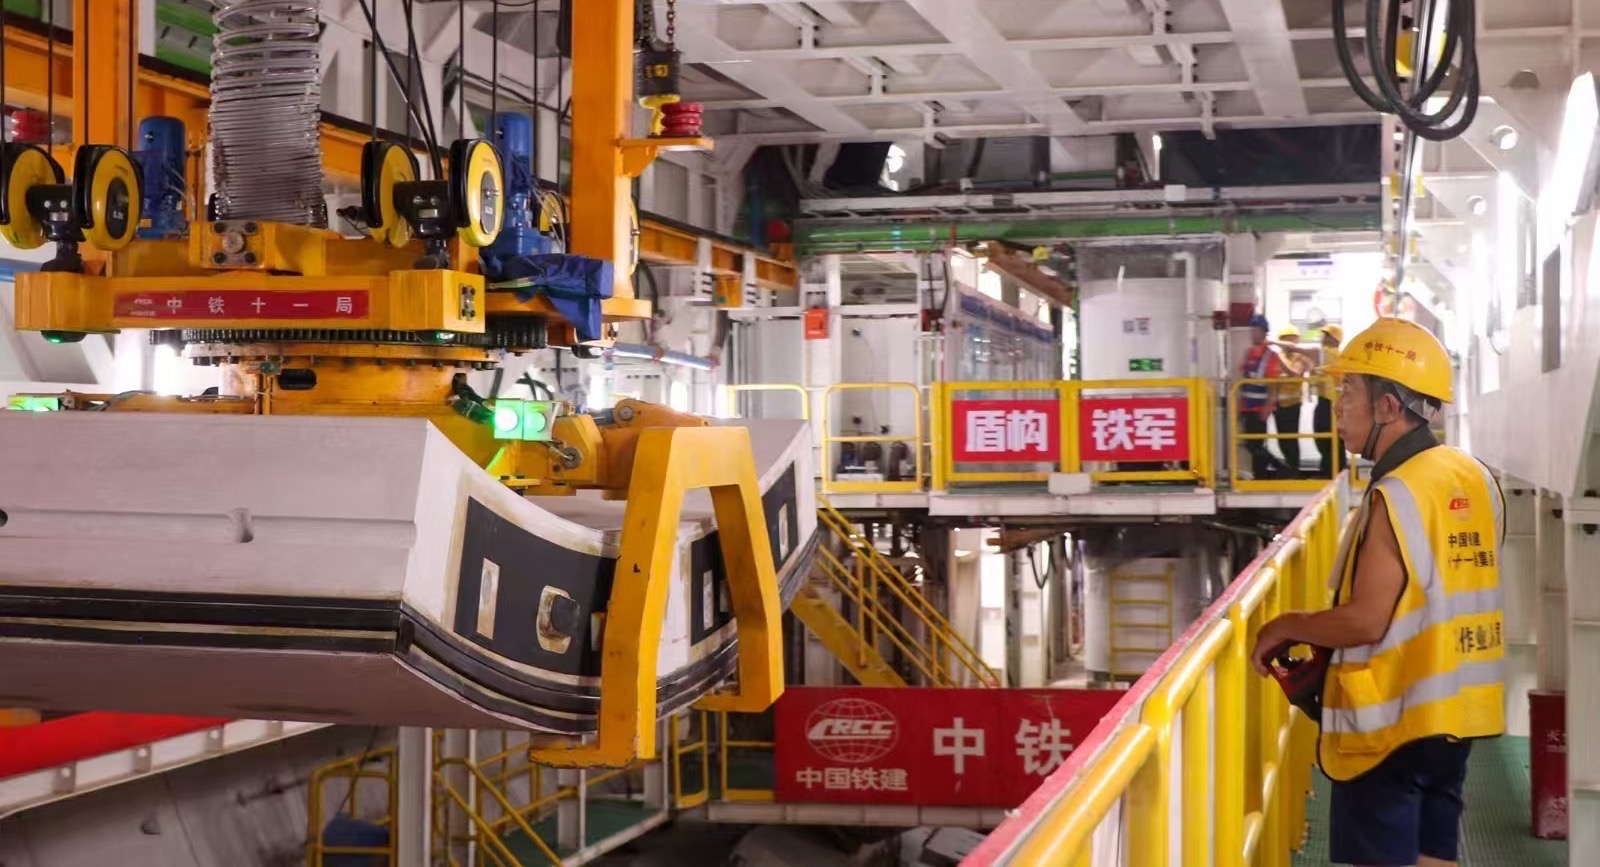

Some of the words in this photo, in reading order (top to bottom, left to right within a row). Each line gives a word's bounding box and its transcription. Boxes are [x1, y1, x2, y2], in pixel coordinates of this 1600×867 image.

[167, 296, 353, 315] 中铁十一局
[965, 409, 1049, 452] 盾构
[1092, 407, 1177, 451] 铁军
[807, 718, 897, 740] CRCC
[933, 717, 1074, 776] 中铁
[796, 767, 909, 791] 中国铁建
